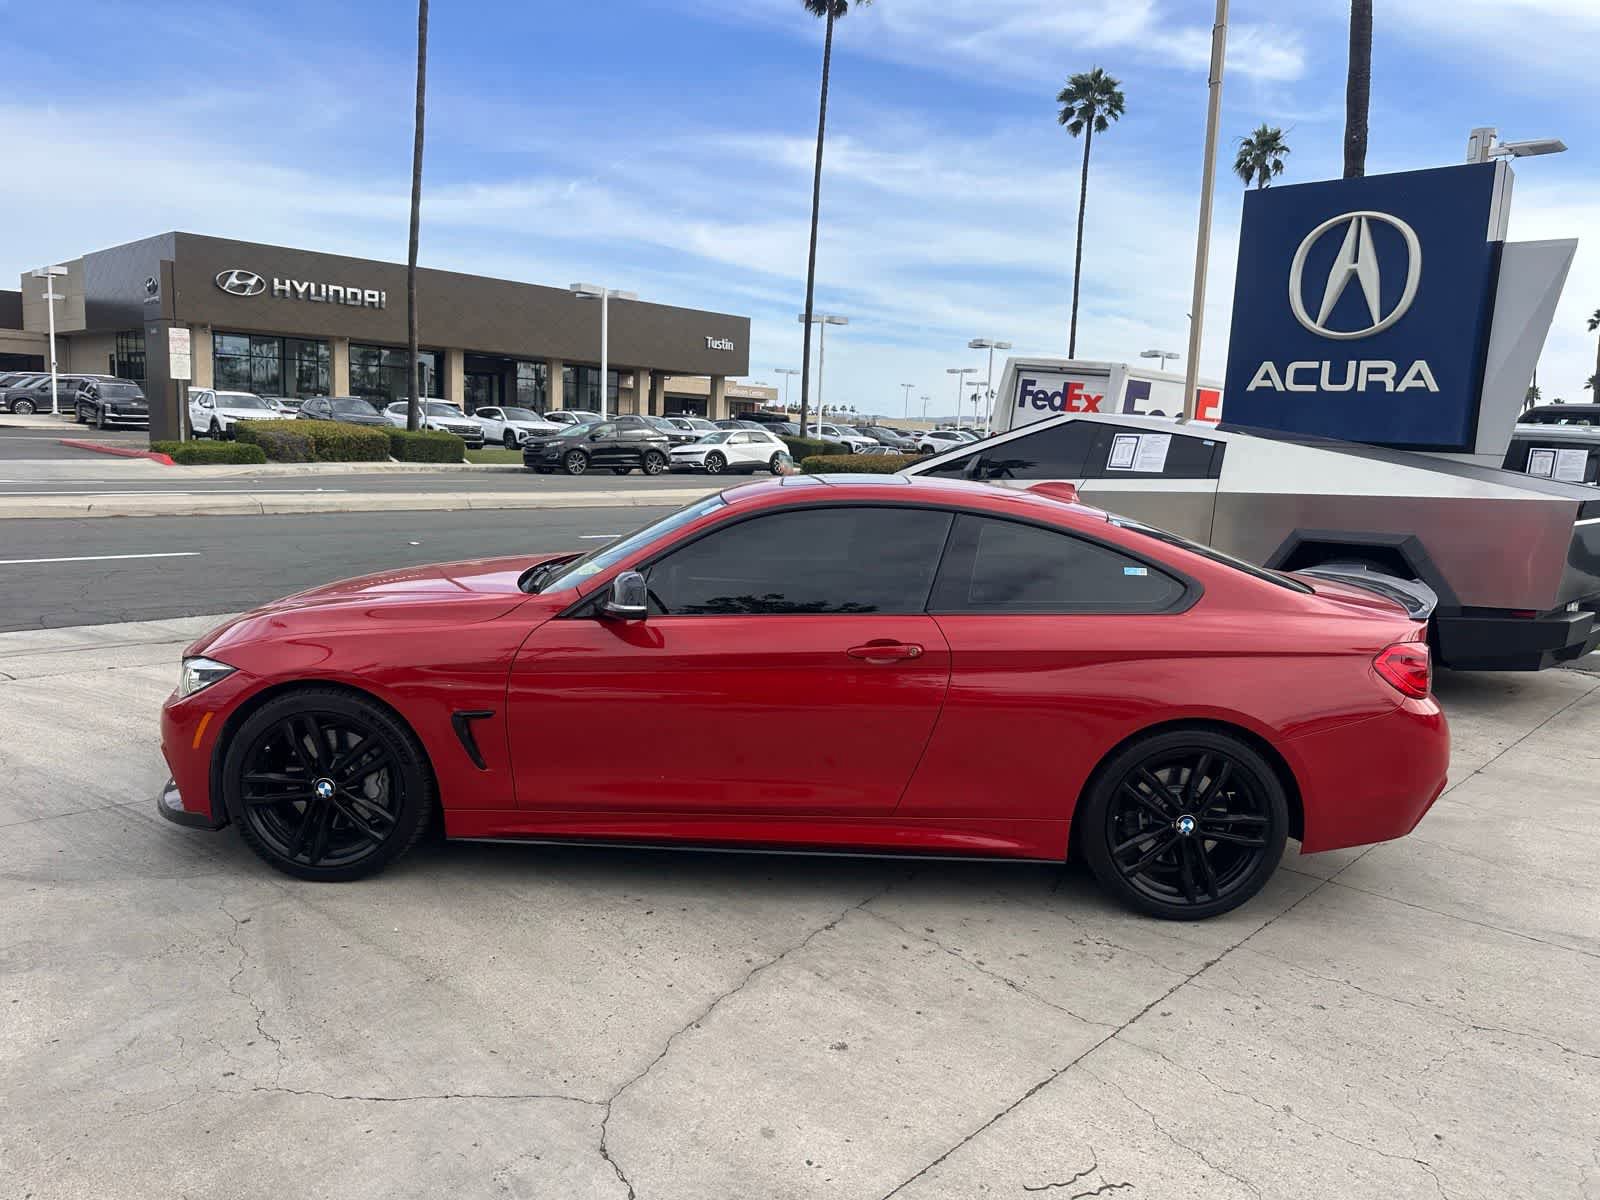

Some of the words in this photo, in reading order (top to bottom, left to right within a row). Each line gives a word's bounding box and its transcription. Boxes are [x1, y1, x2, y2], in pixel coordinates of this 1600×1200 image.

[273, 278, 386, 309] HYUNDAI
[705, 336, 734, 351] Tustin
[1246, 360, 1440, 392] ACURA
[1018, 378, 1104, 413] FedEx
